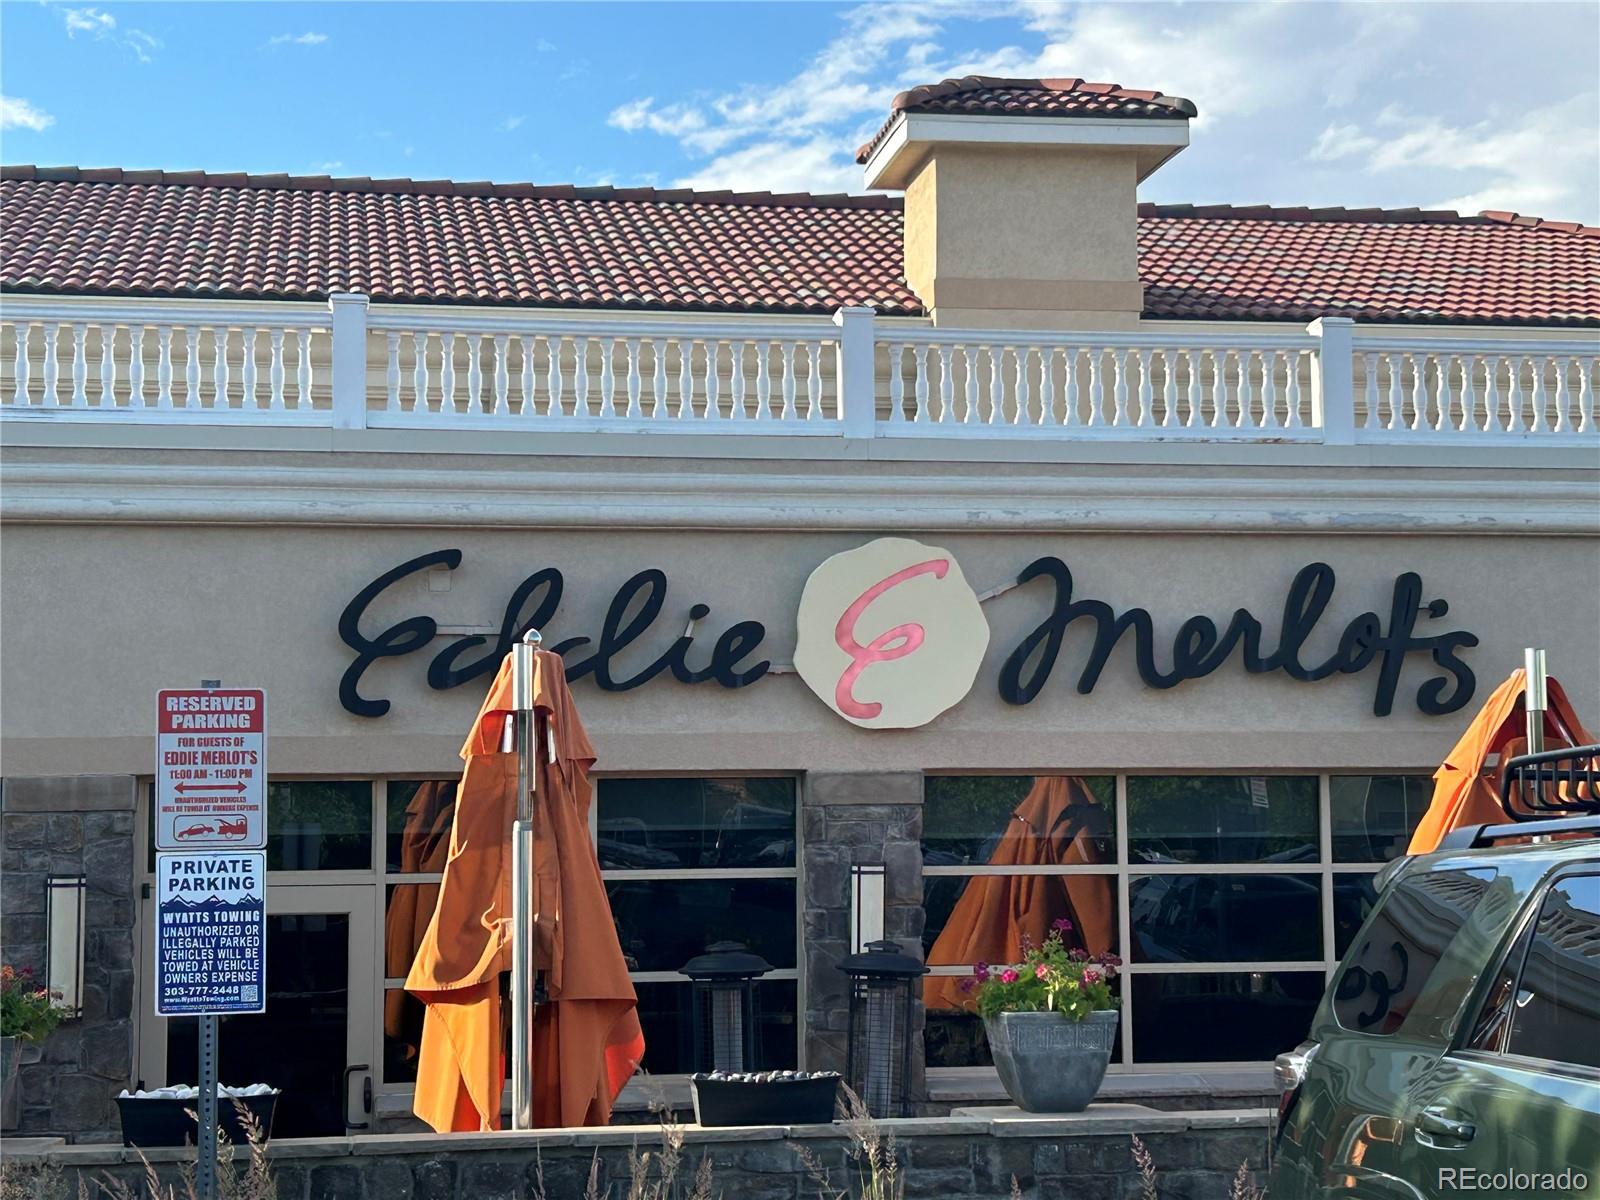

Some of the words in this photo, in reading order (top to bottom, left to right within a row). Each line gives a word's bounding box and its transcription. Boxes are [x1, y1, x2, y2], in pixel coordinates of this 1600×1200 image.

[338, 548, 771, 717] Eddie
[997, 556, 1480, 718] Merlot's
[166, 696, 256, 711] RESERVED
[171, 714, 250, 729] PARKING
[177, 738, 196, 747] FOR
[197, 737, 232, 747] GUESTS
[234, 737, 245, 746] OF
[164, 751, 199, 765] EDDIE
[201, 750, 258, 765] MERLOT'S
[169, 769, 192, 779] 11:00
[193, 769, 207, 779] AM
[214, 768, 237, 778] 11:00
[239, 768, 252, 778] PM
[171, 859, 253, 875] PRIVATE
[169, 877, 255, 892] PARKING
[163, 912, 209, 924] WYATTS
[213, 910, 260, 922] TOWING
[163, 925, 242, 937] UNAUTHORIZED
[245, 925, 259, 935] OR
[162, 937, 217, 949] ILLEGALLY
[220, 936, 260, 947] PARKED
[164, 949, 214, 960] VEHICLES
[217, 948, 241, 959] WILL
[245, 948, 258, 958] BE
[162, 961, 199, 972] TOWED
[201, 960, 213, 971] AT
[217, 959, 259, 970] VEHICLE
[164, 972, 208, 984] OWNERS
[211, 971, 258, 983] EXPENSE
[164, 986, 239, 996] 303-777-2448
